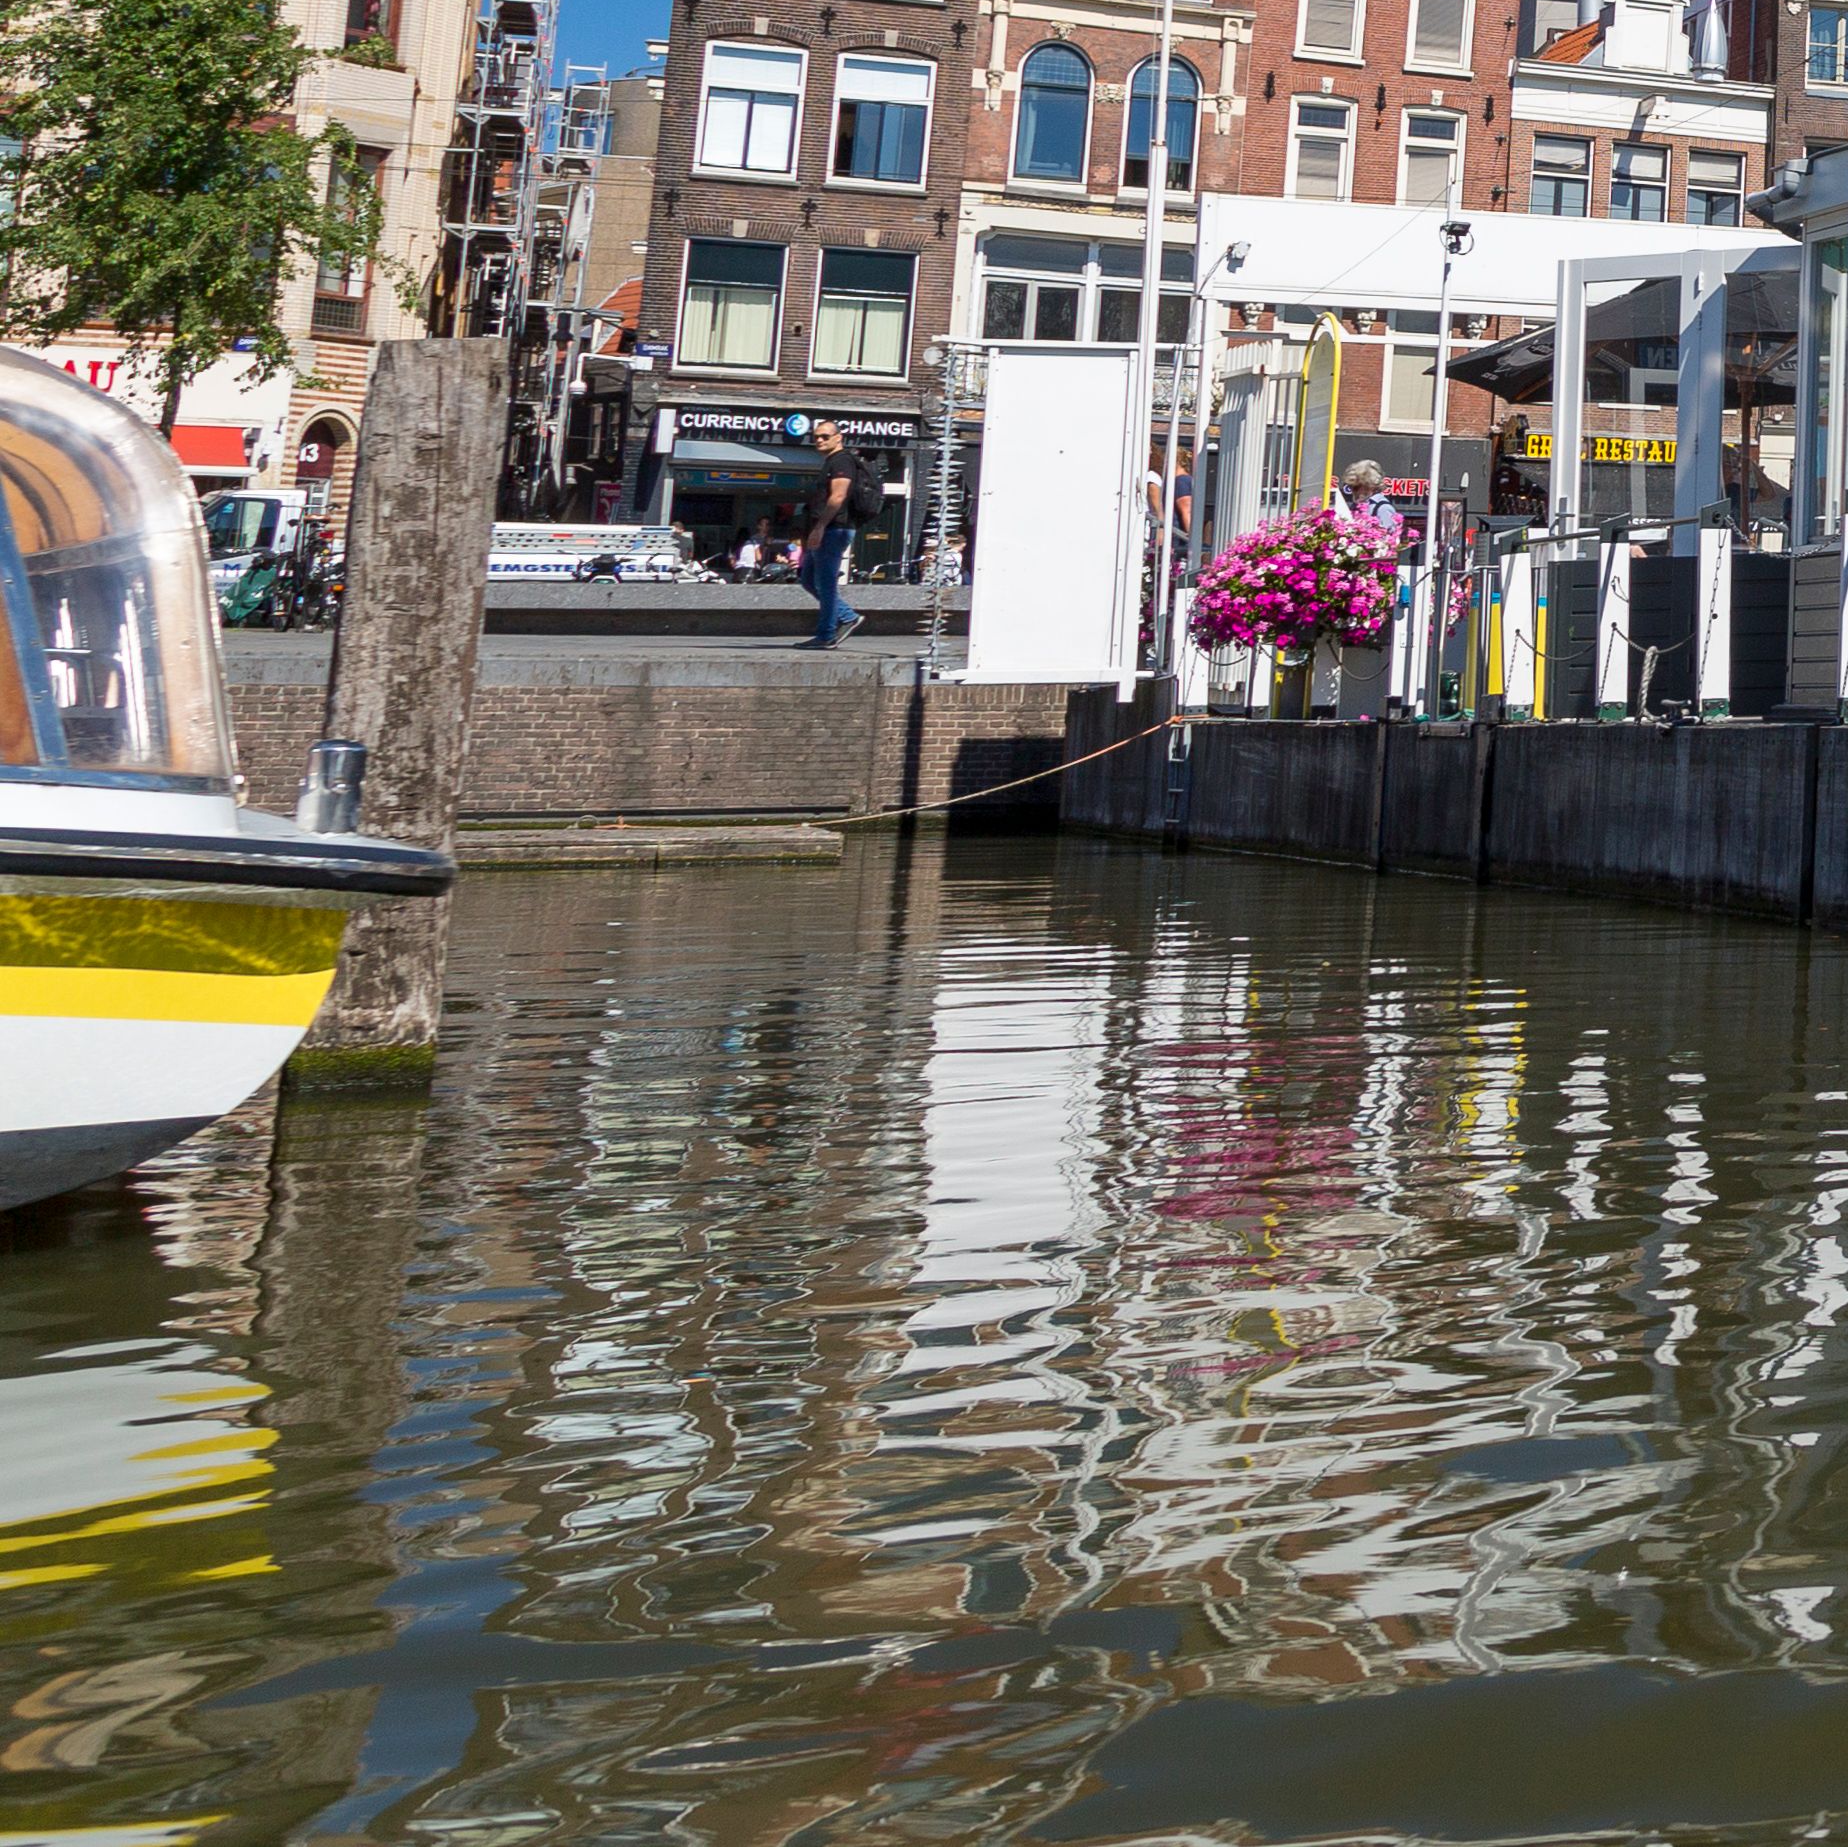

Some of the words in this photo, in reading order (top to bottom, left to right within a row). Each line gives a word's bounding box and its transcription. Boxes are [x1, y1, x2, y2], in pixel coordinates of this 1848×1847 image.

[680, 413, 783, 431] CURRENCY
[813, 418, 913, 437] ECHANGE
[298, 443, 320, 463] 13
